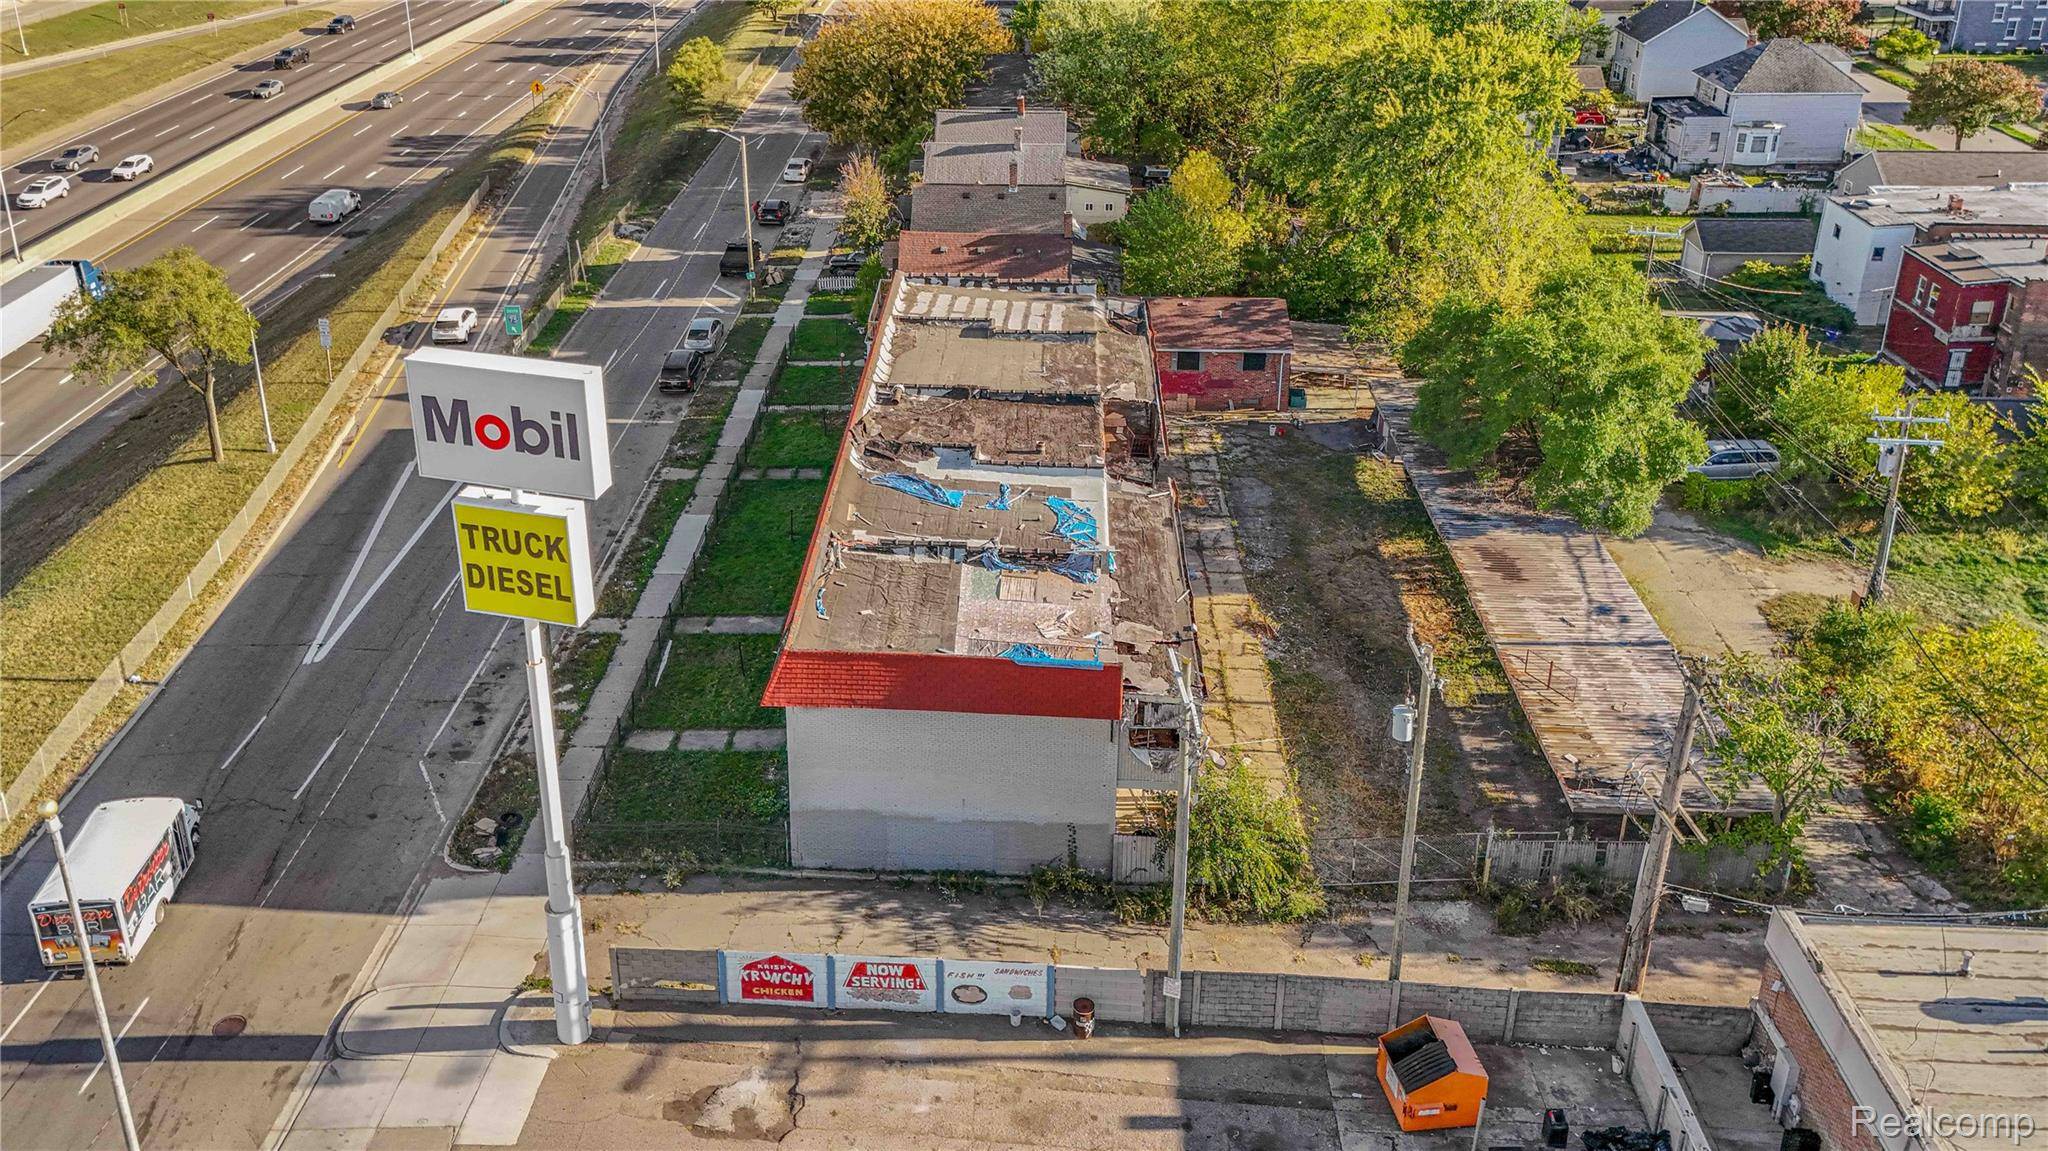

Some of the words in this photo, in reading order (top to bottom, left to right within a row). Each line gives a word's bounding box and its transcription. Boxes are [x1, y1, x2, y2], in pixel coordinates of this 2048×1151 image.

[421, 395, 581, 461] Mobil
[460, 523, 567, 564] TRUCK
[466, 563, 572, 603] DIESEL
[138, 867, 164, 916] BAR
[741, 969, 815, 985] KRUNCHY
[867, 964, 904, 976] NOW
[947, 971, 975, 979] FISH
[994, 968, 1043, 976] SANDWICHES
[851, 976, 921, 989] SERVING!
[752, 987, 804, 996] CHICKEN
